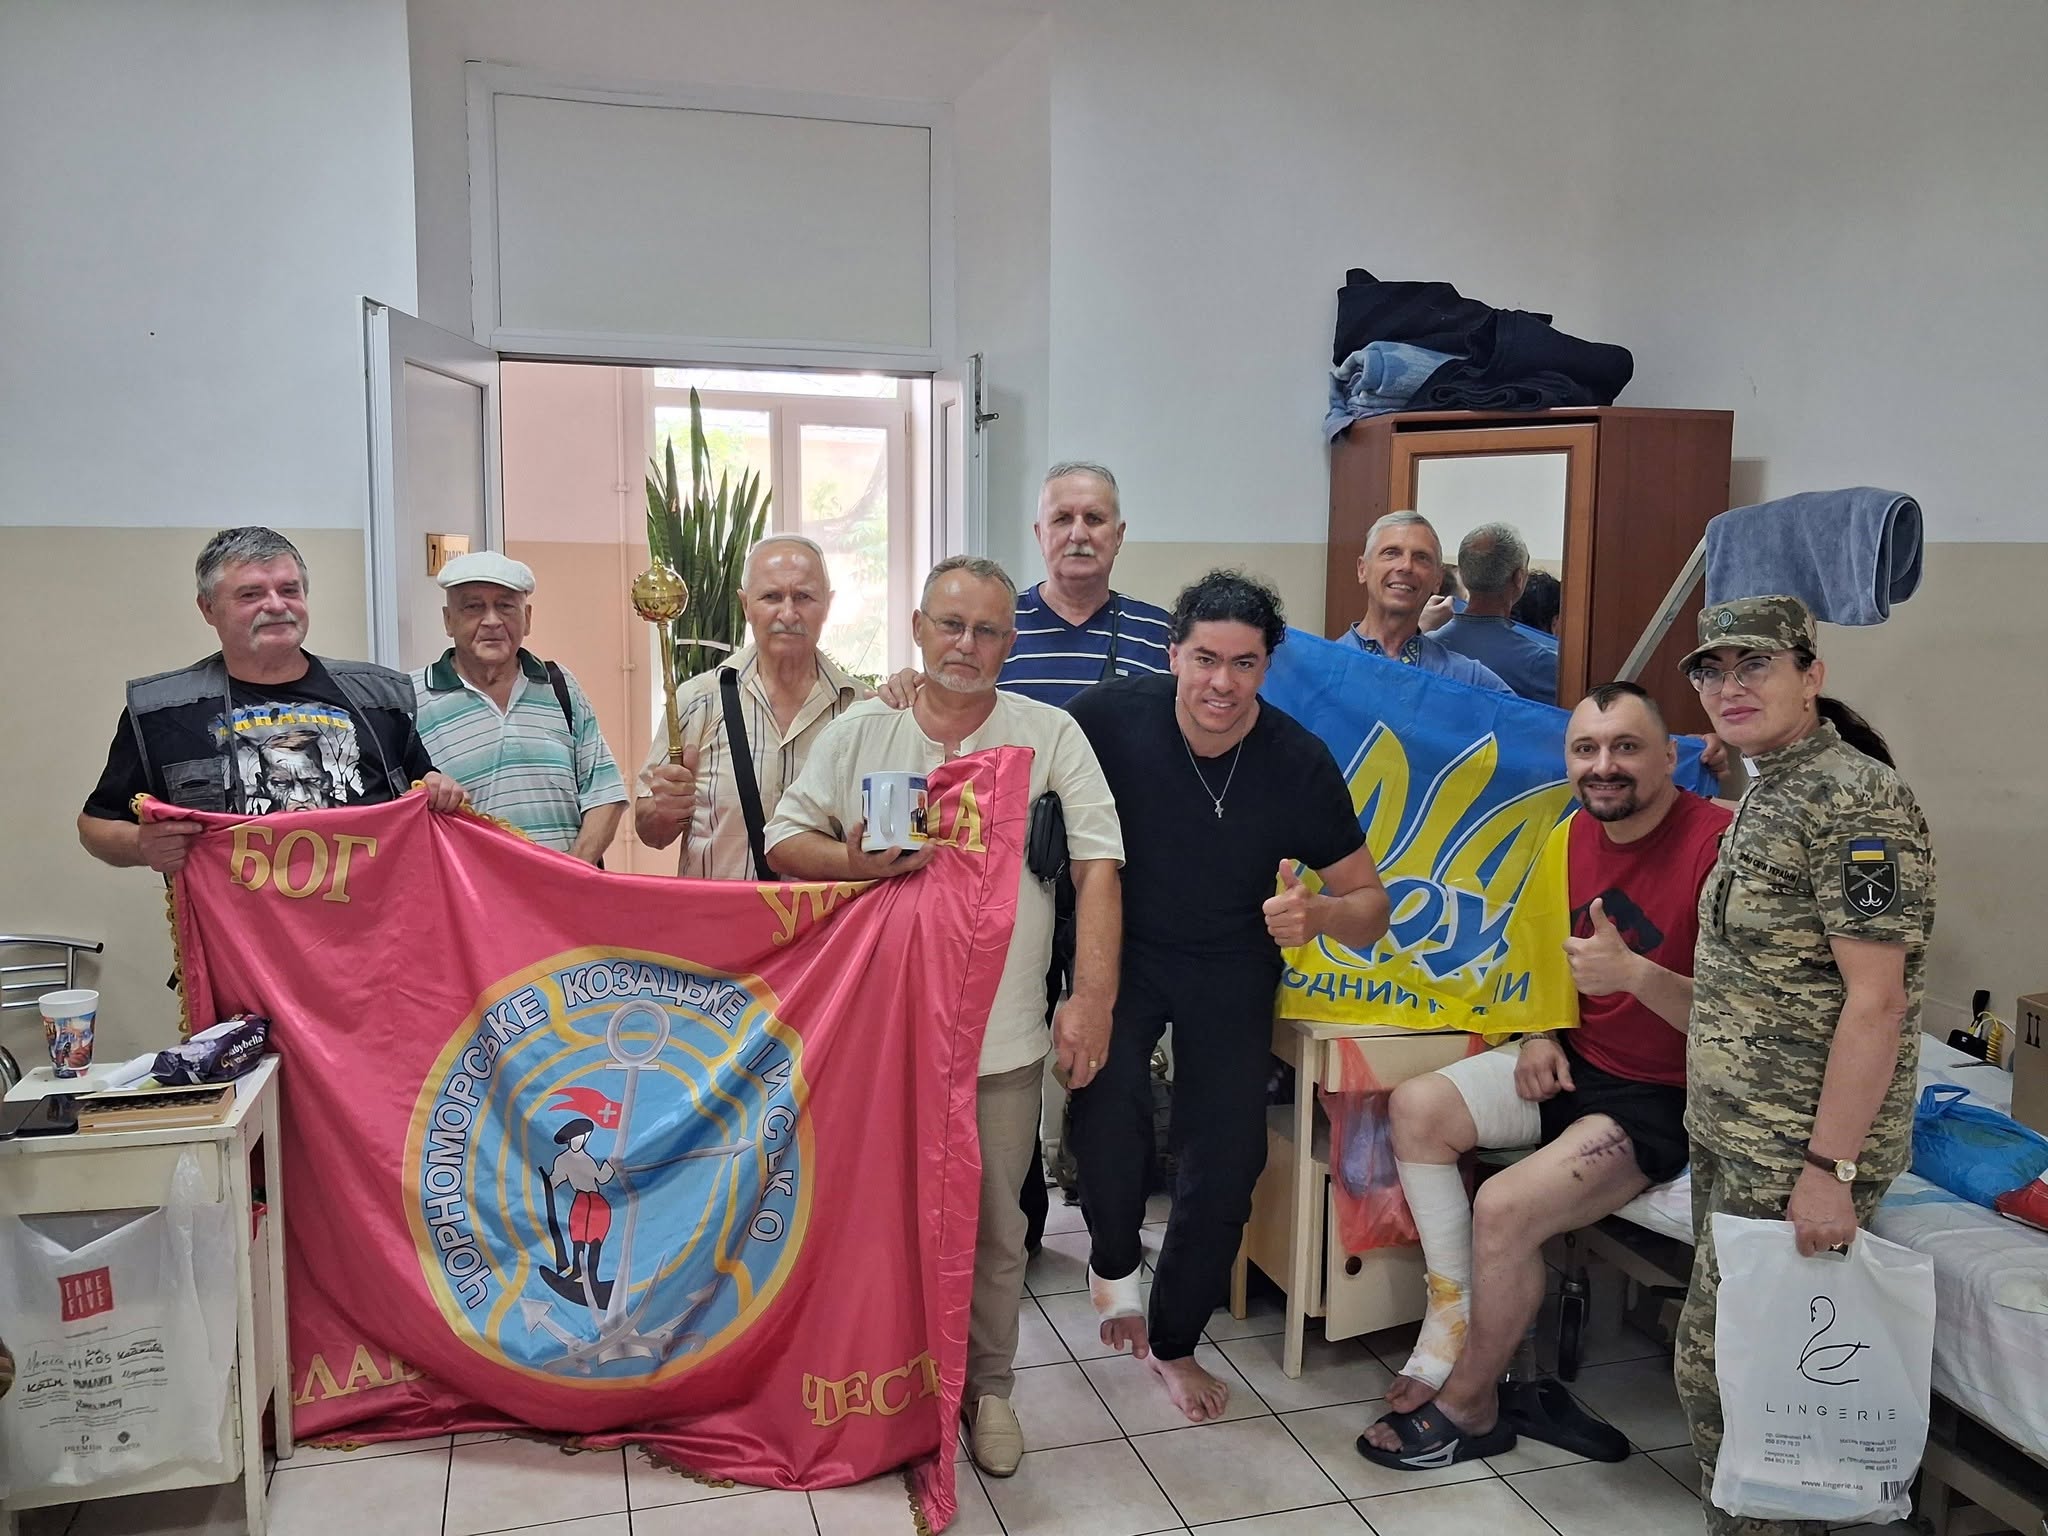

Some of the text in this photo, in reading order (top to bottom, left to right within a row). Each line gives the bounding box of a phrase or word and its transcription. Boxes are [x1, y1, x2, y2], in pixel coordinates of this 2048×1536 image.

[230, 824, 378, 904] БОГ
[425, 990, 548, 1309] ЧОРНОМОРСЬКЕ
[561, 963, 747, 1029] КОЗАЦЬКЕ
[68, 1290, 105, 1315] FIVE
[1766, 1402, 1896, 1421] LINGERIE
[1801, 1480, 1864, 1491] www.lingerie.ua
